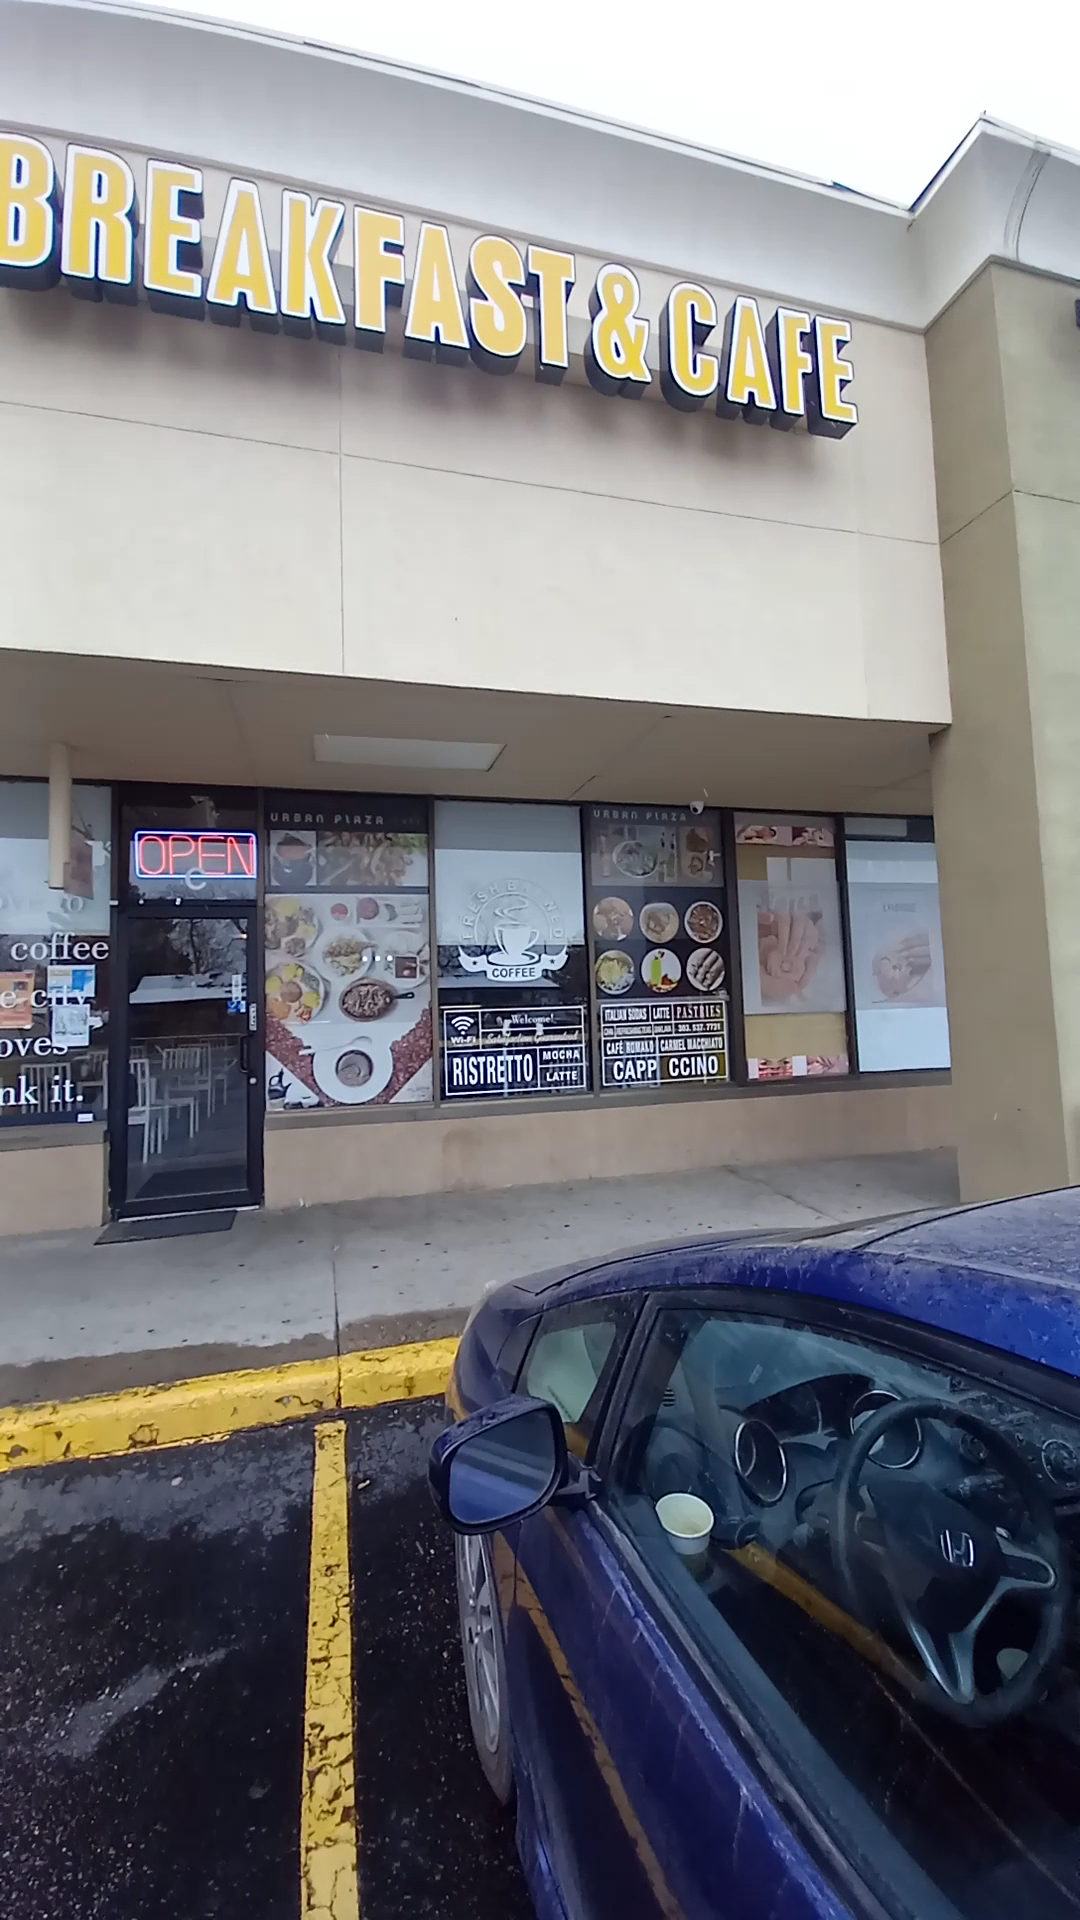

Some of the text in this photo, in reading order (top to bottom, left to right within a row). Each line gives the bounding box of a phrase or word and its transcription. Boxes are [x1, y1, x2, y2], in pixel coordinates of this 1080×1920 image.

[0, 132, 858, 424] BREAKFAST & CAFE
[270, 812, 324, 823] URBAN
[334, 814, 384, 825] PLAZA
[138, 834, 255, 876] OPEN
[11, 931, 109, 961] coffee
[491, 967, 536, 978] COFFEE
[653, 1006, 671, 1019] LATTE
[676, 1004, 721, 1019] PASTRIES
[542, 1050, 580, 1060] MOCHA
[452, 1054, 533, 1086] RISTRETTO
[546, 1070, 578, 1082] LATTE
